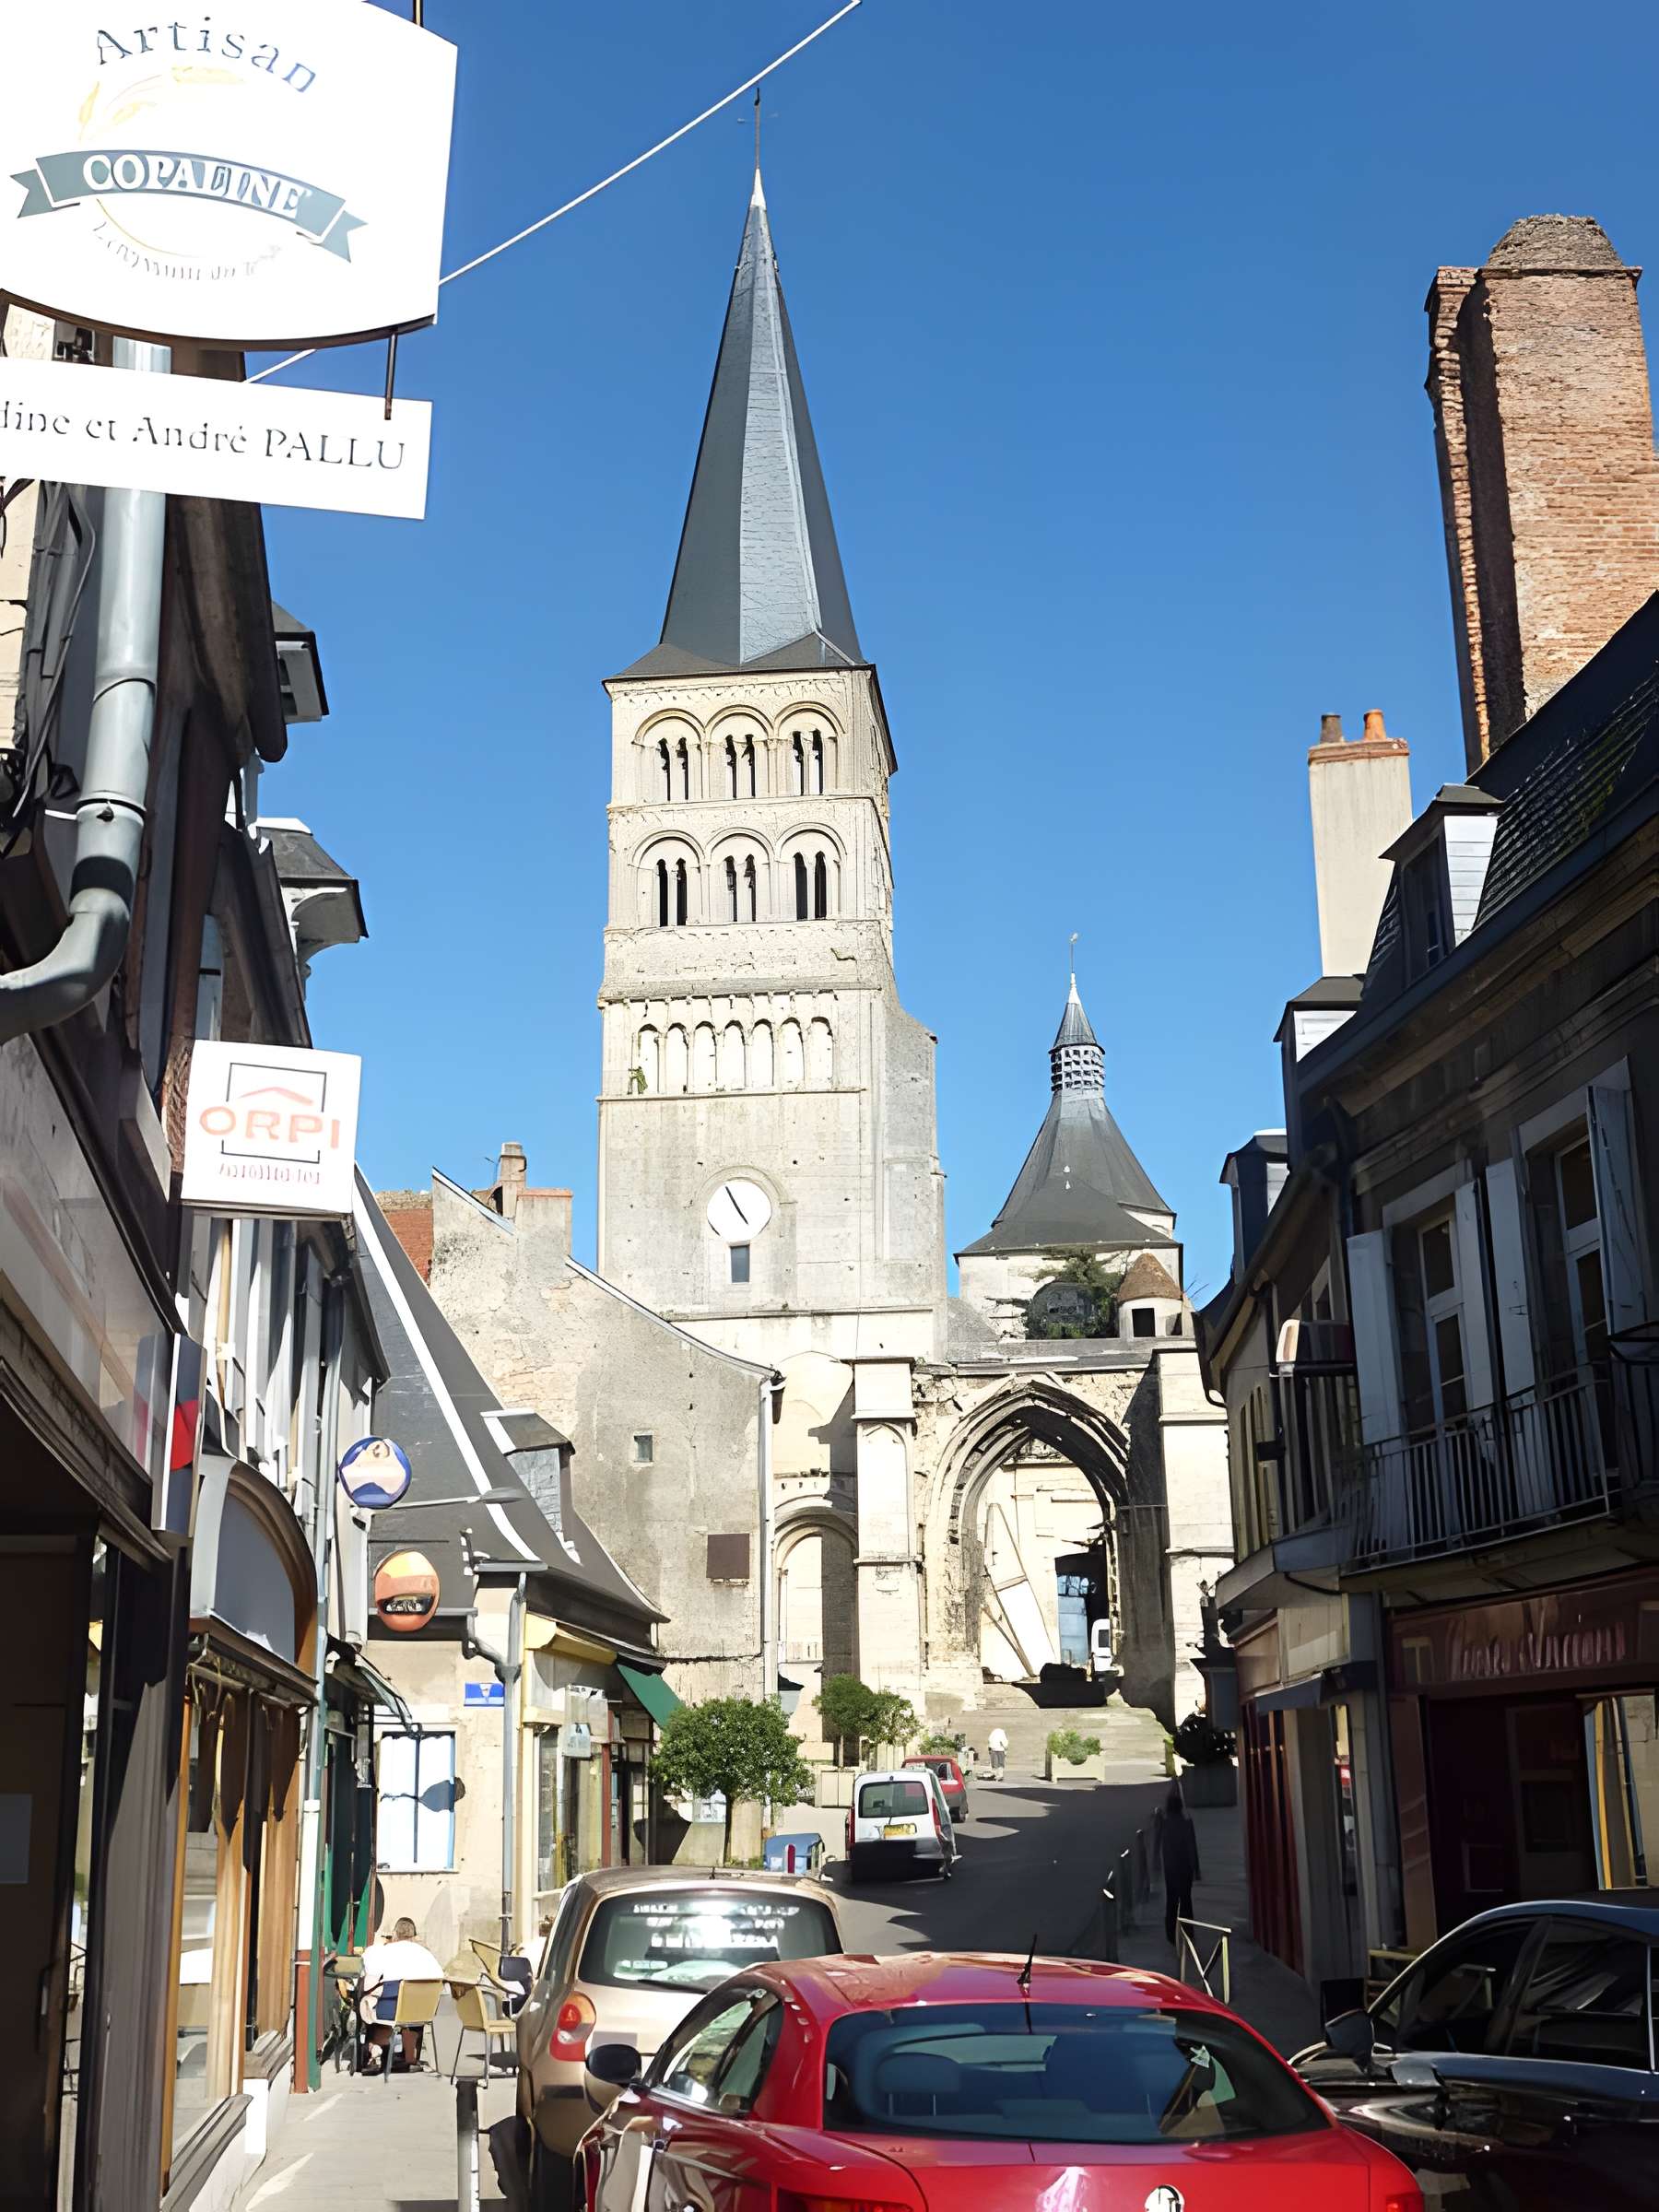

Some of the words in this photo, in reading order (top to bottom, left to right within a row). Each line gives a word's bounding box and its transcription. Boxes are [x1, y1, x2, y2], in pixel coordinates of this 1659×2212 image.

[97, 16, 317, 93] Artisan
[85, 418, 117, 441] et
[132, 417, 247, 453] André
[265, 428, 406, 470] PALLU
[198, 1105, 340, 1150] ORPI
